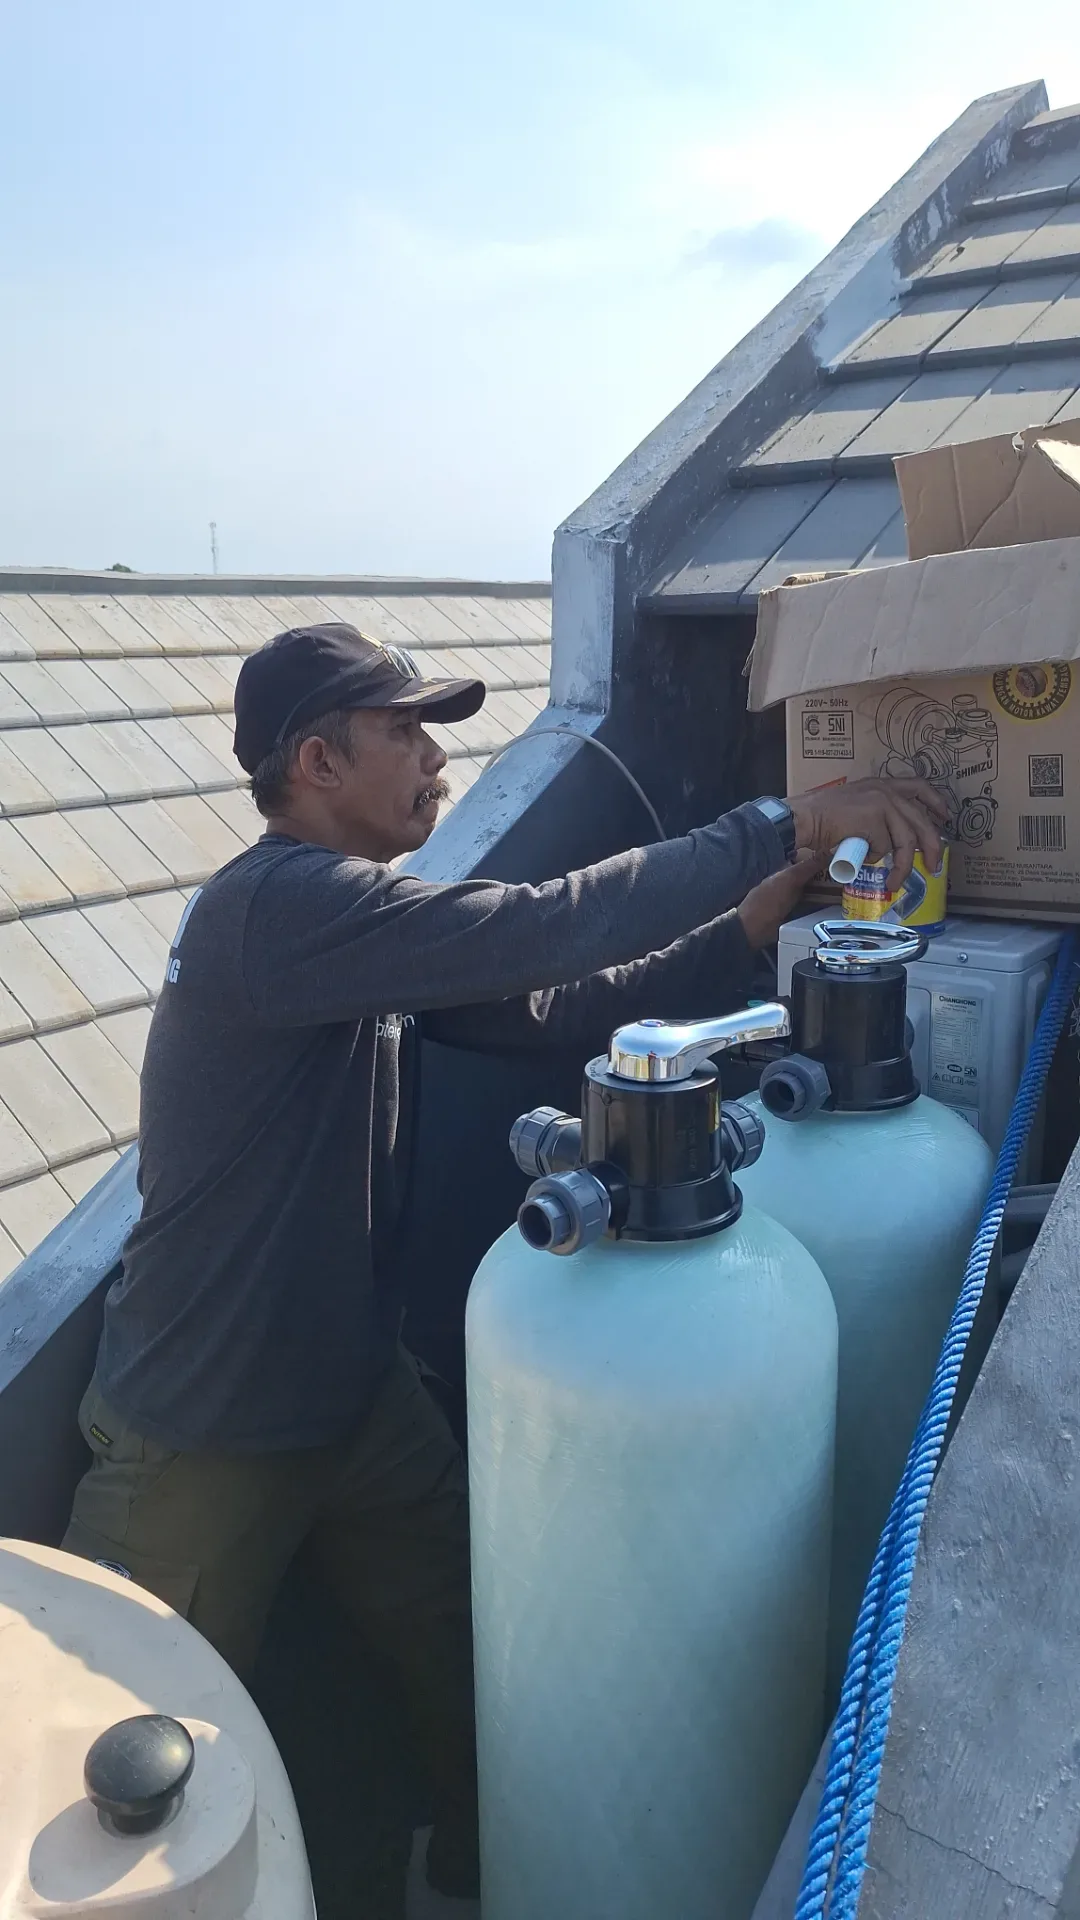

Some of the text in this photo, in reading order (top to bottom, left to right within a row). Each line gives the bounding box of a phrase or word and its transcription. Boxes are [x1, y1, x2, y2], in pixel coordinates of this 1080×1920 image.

[829, 698, 848, 707] 50Hz
[1009, 704, 1034, 718] MOTOR
[1036, 698, 1060, 716] KAWAT
[828, 718, 845, 732] SNI
[956, 759, 993, 780] SHIMIZU
[857, 869, 884, 882] Glue
[939, 995, 977, 1007] CHANGHONG
